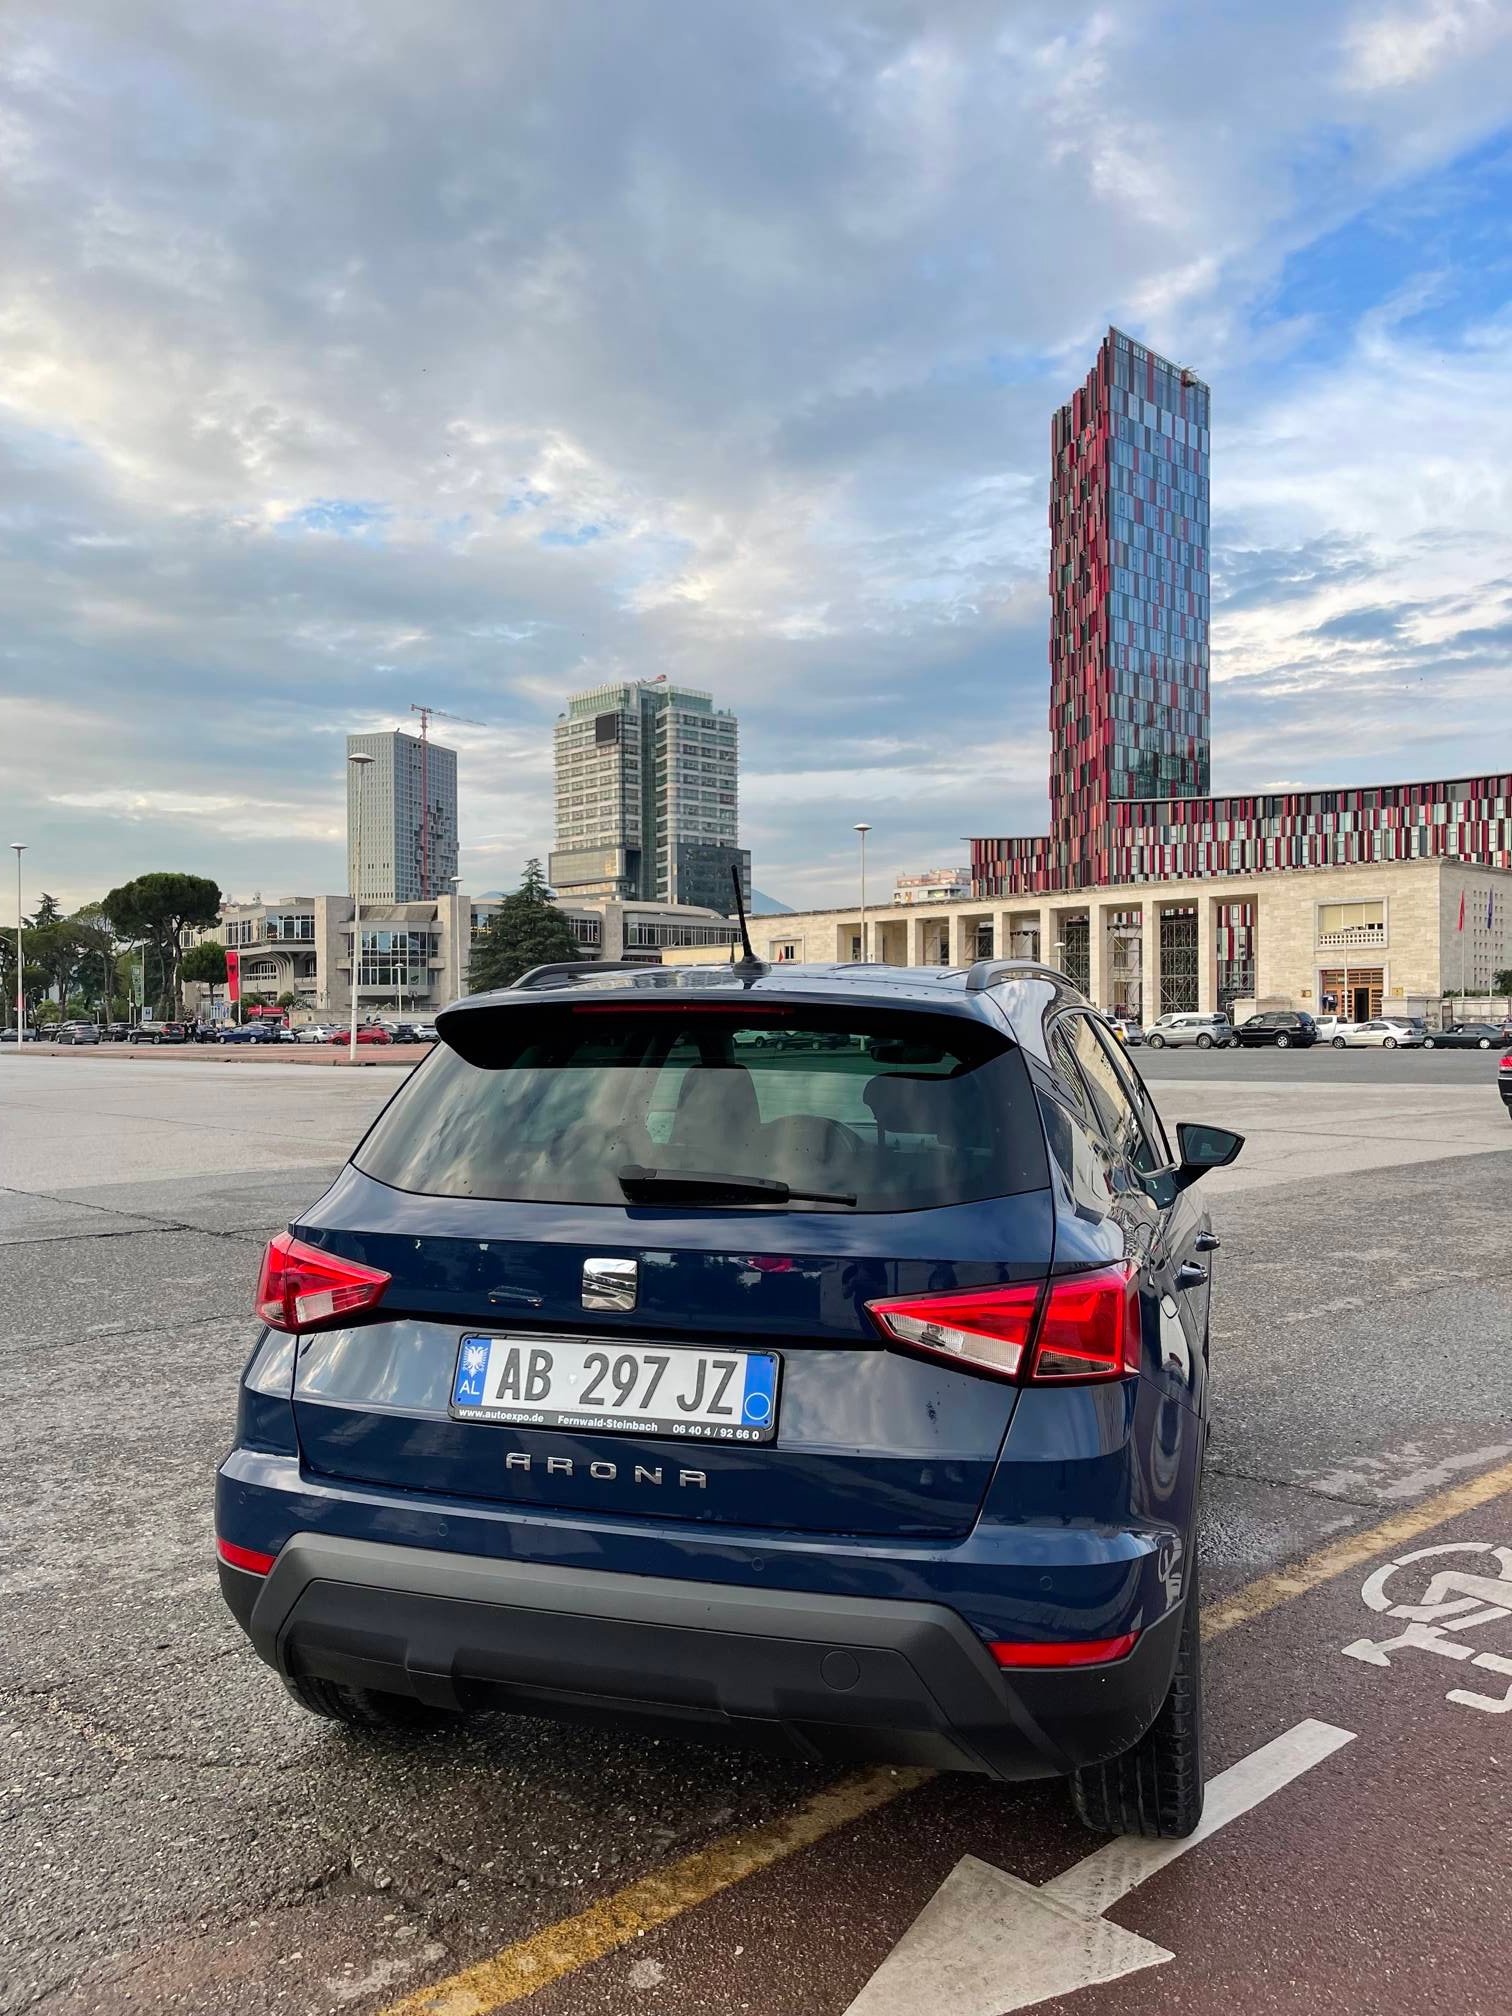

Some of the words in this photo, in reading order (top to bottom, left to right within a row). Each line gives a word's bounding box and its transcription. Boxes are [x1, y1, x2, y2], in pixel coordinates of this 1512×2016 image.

[459, 1379, 480, 1396] AL
[495, 1347, 554, 1402] AB
[579, 1352, 671, 1410] 297
[676, 1358, 738, 1416] JZ
[458, 1408, 545, 1424] www.autoexpo.de
[557, 1415, 659, 1433] Fernwald-Steinbach
[672, 1424, 686, 1434] 06
[688, 1425, 702, 1436] 40
[703, 1426, 711, 1437] 4
[720, 1427, 733, 1438] 92
[736, 1429, 750, 1440] 66
[751, 1430, 760, 1440] 0
[505, 1452, 708, 1489] ARONA
